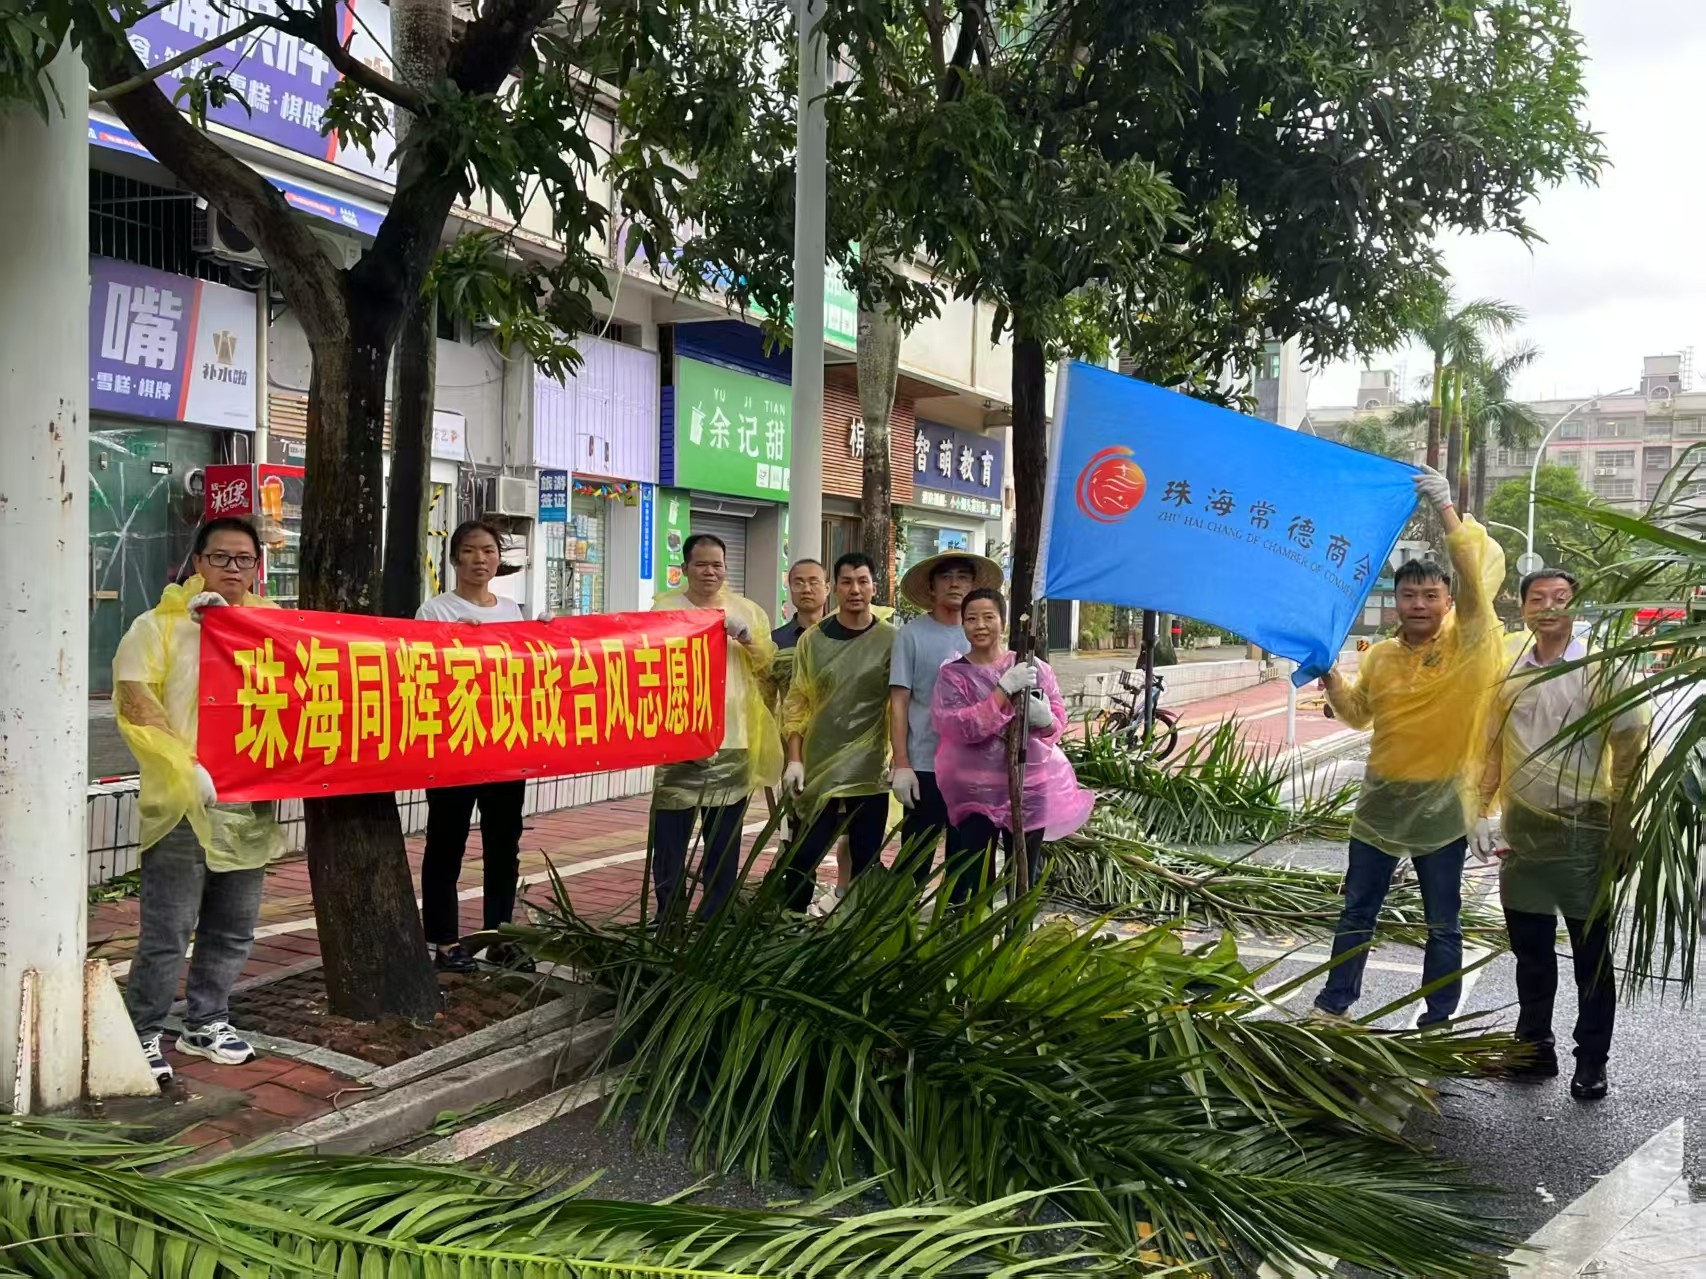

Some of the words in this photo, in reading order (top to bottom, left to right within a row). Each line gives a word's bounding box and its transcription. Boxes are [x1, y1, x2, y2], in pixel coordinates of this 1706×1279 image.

[713, 388, 726, 402] YU
[744, 396, 752, 408] JI
[764, 400, 786, 416] TIAN
[709, 406, 785, 460] 余记甜
[915, 428, 994, 488] 智萌教育
[540, 492, 566, 508] 签证
[1158, 511, 1178, 522] ZHU
[1184, 516, 1204, 529] HAI
[1207, 521, 1242, 539] CHANG
[1263, 540, 1309, 568] CHAMBER
[1161, 479, 1370, 586] 珠海常德商会
[233, 633, 713, 769] 珠海同辉家政战台风志愿队
